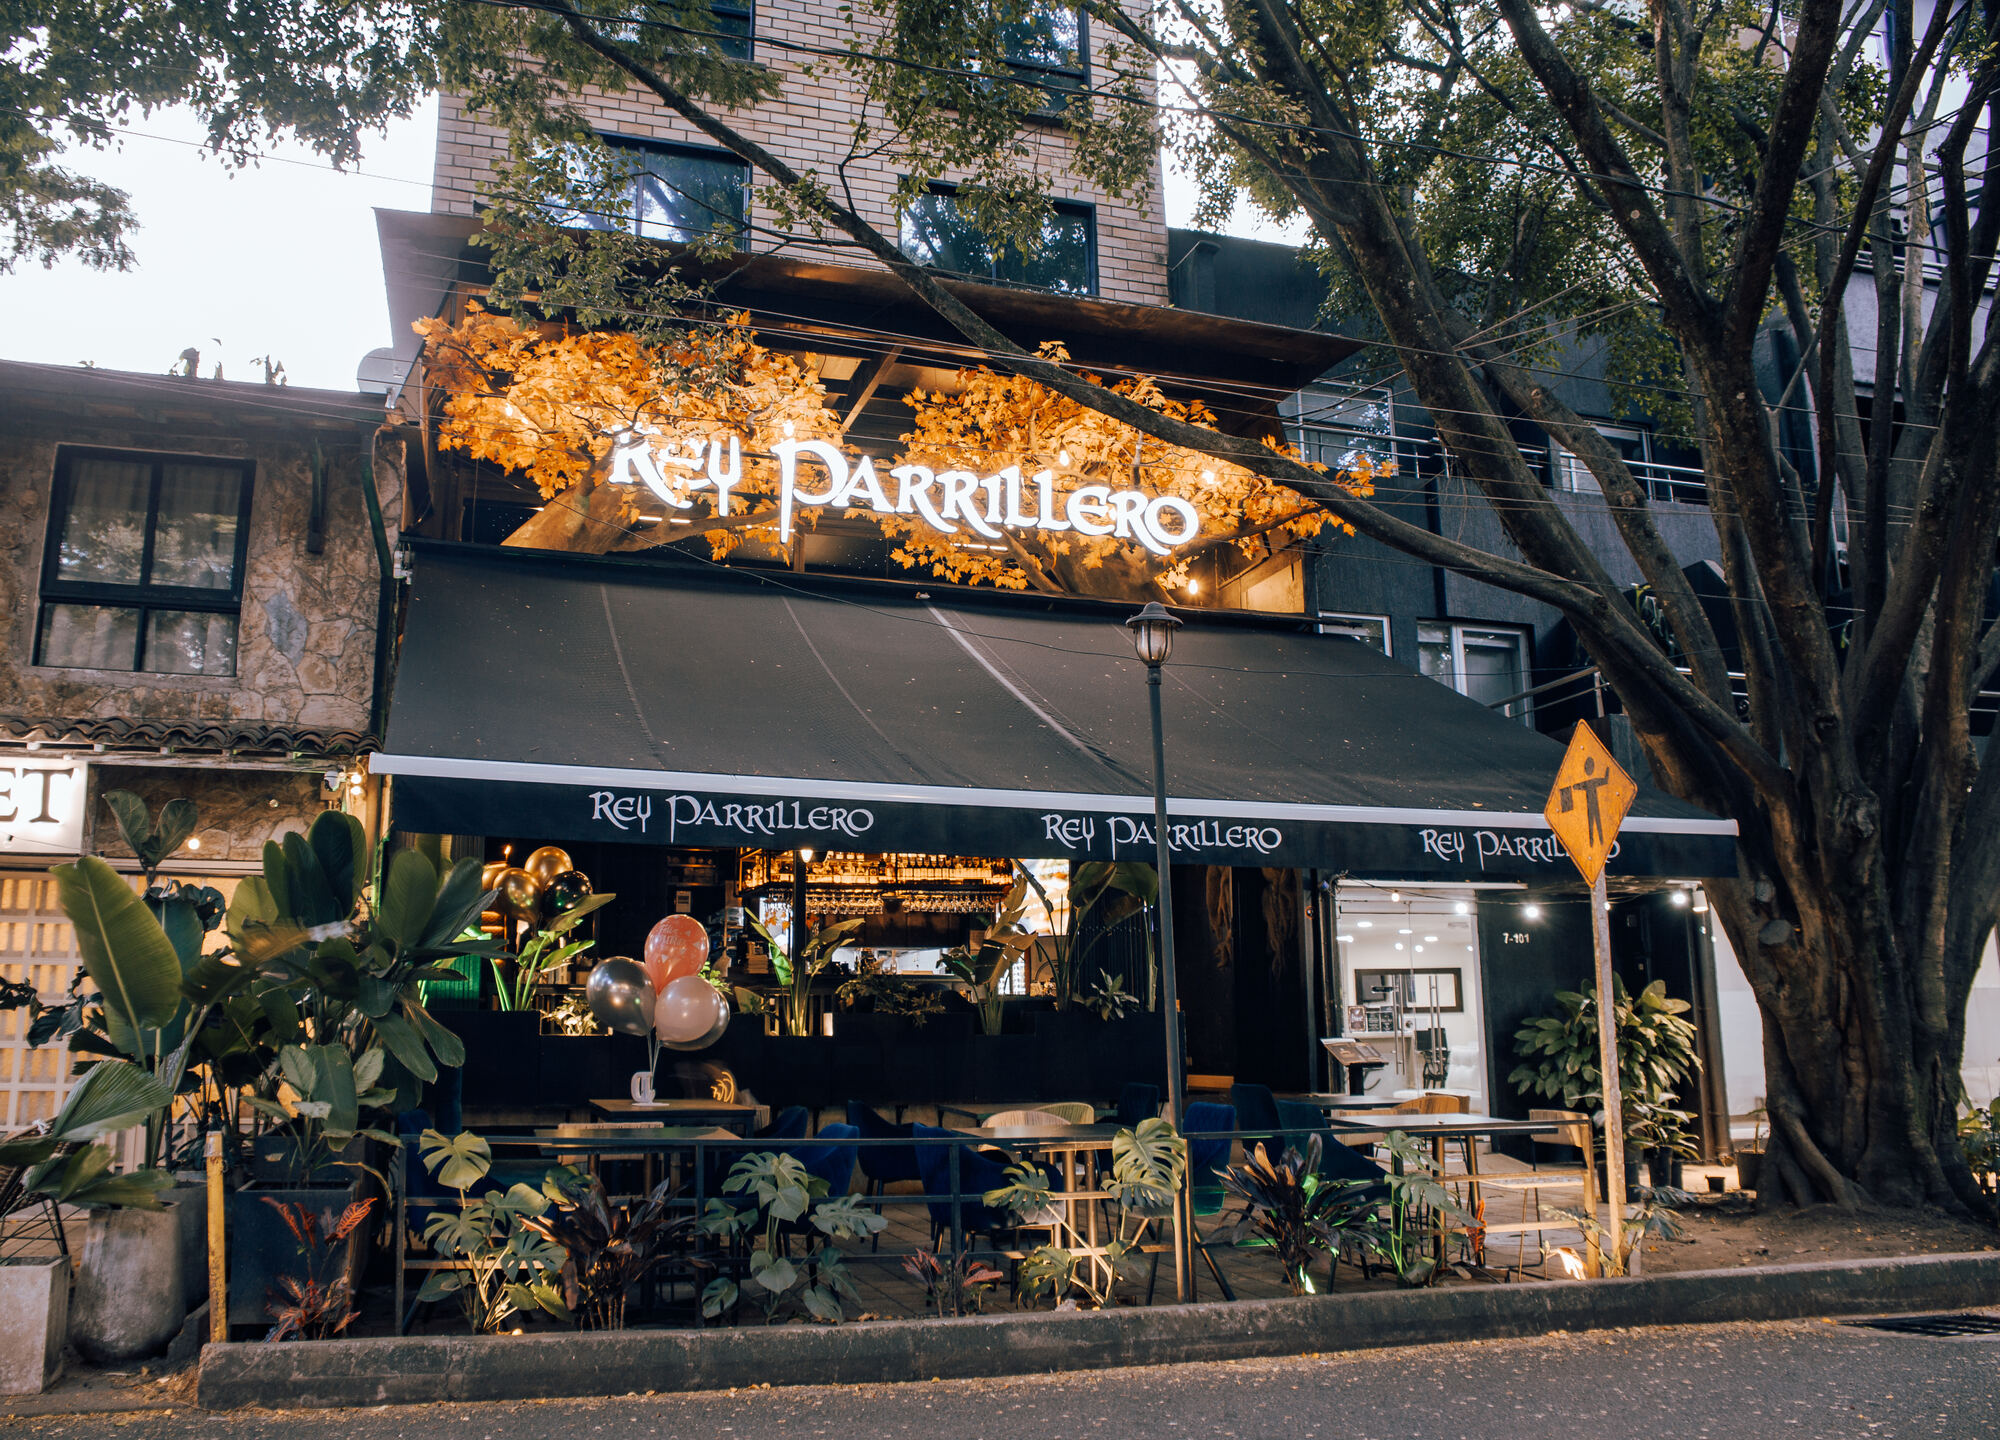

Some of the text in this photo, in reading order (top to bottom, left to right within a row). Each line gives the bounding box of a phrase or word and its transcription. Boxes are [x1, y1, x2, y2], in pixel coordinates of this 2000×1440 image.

[770, 437, 1200, 556] PARRILLERO
[588, 791, 874, 844] REY PARRILLERO
[1040, 813, 1095, 852] REY
[1419, 828, 1621, 871] REY PARRILO
[1502, 932, 1530, 945] 7-101
